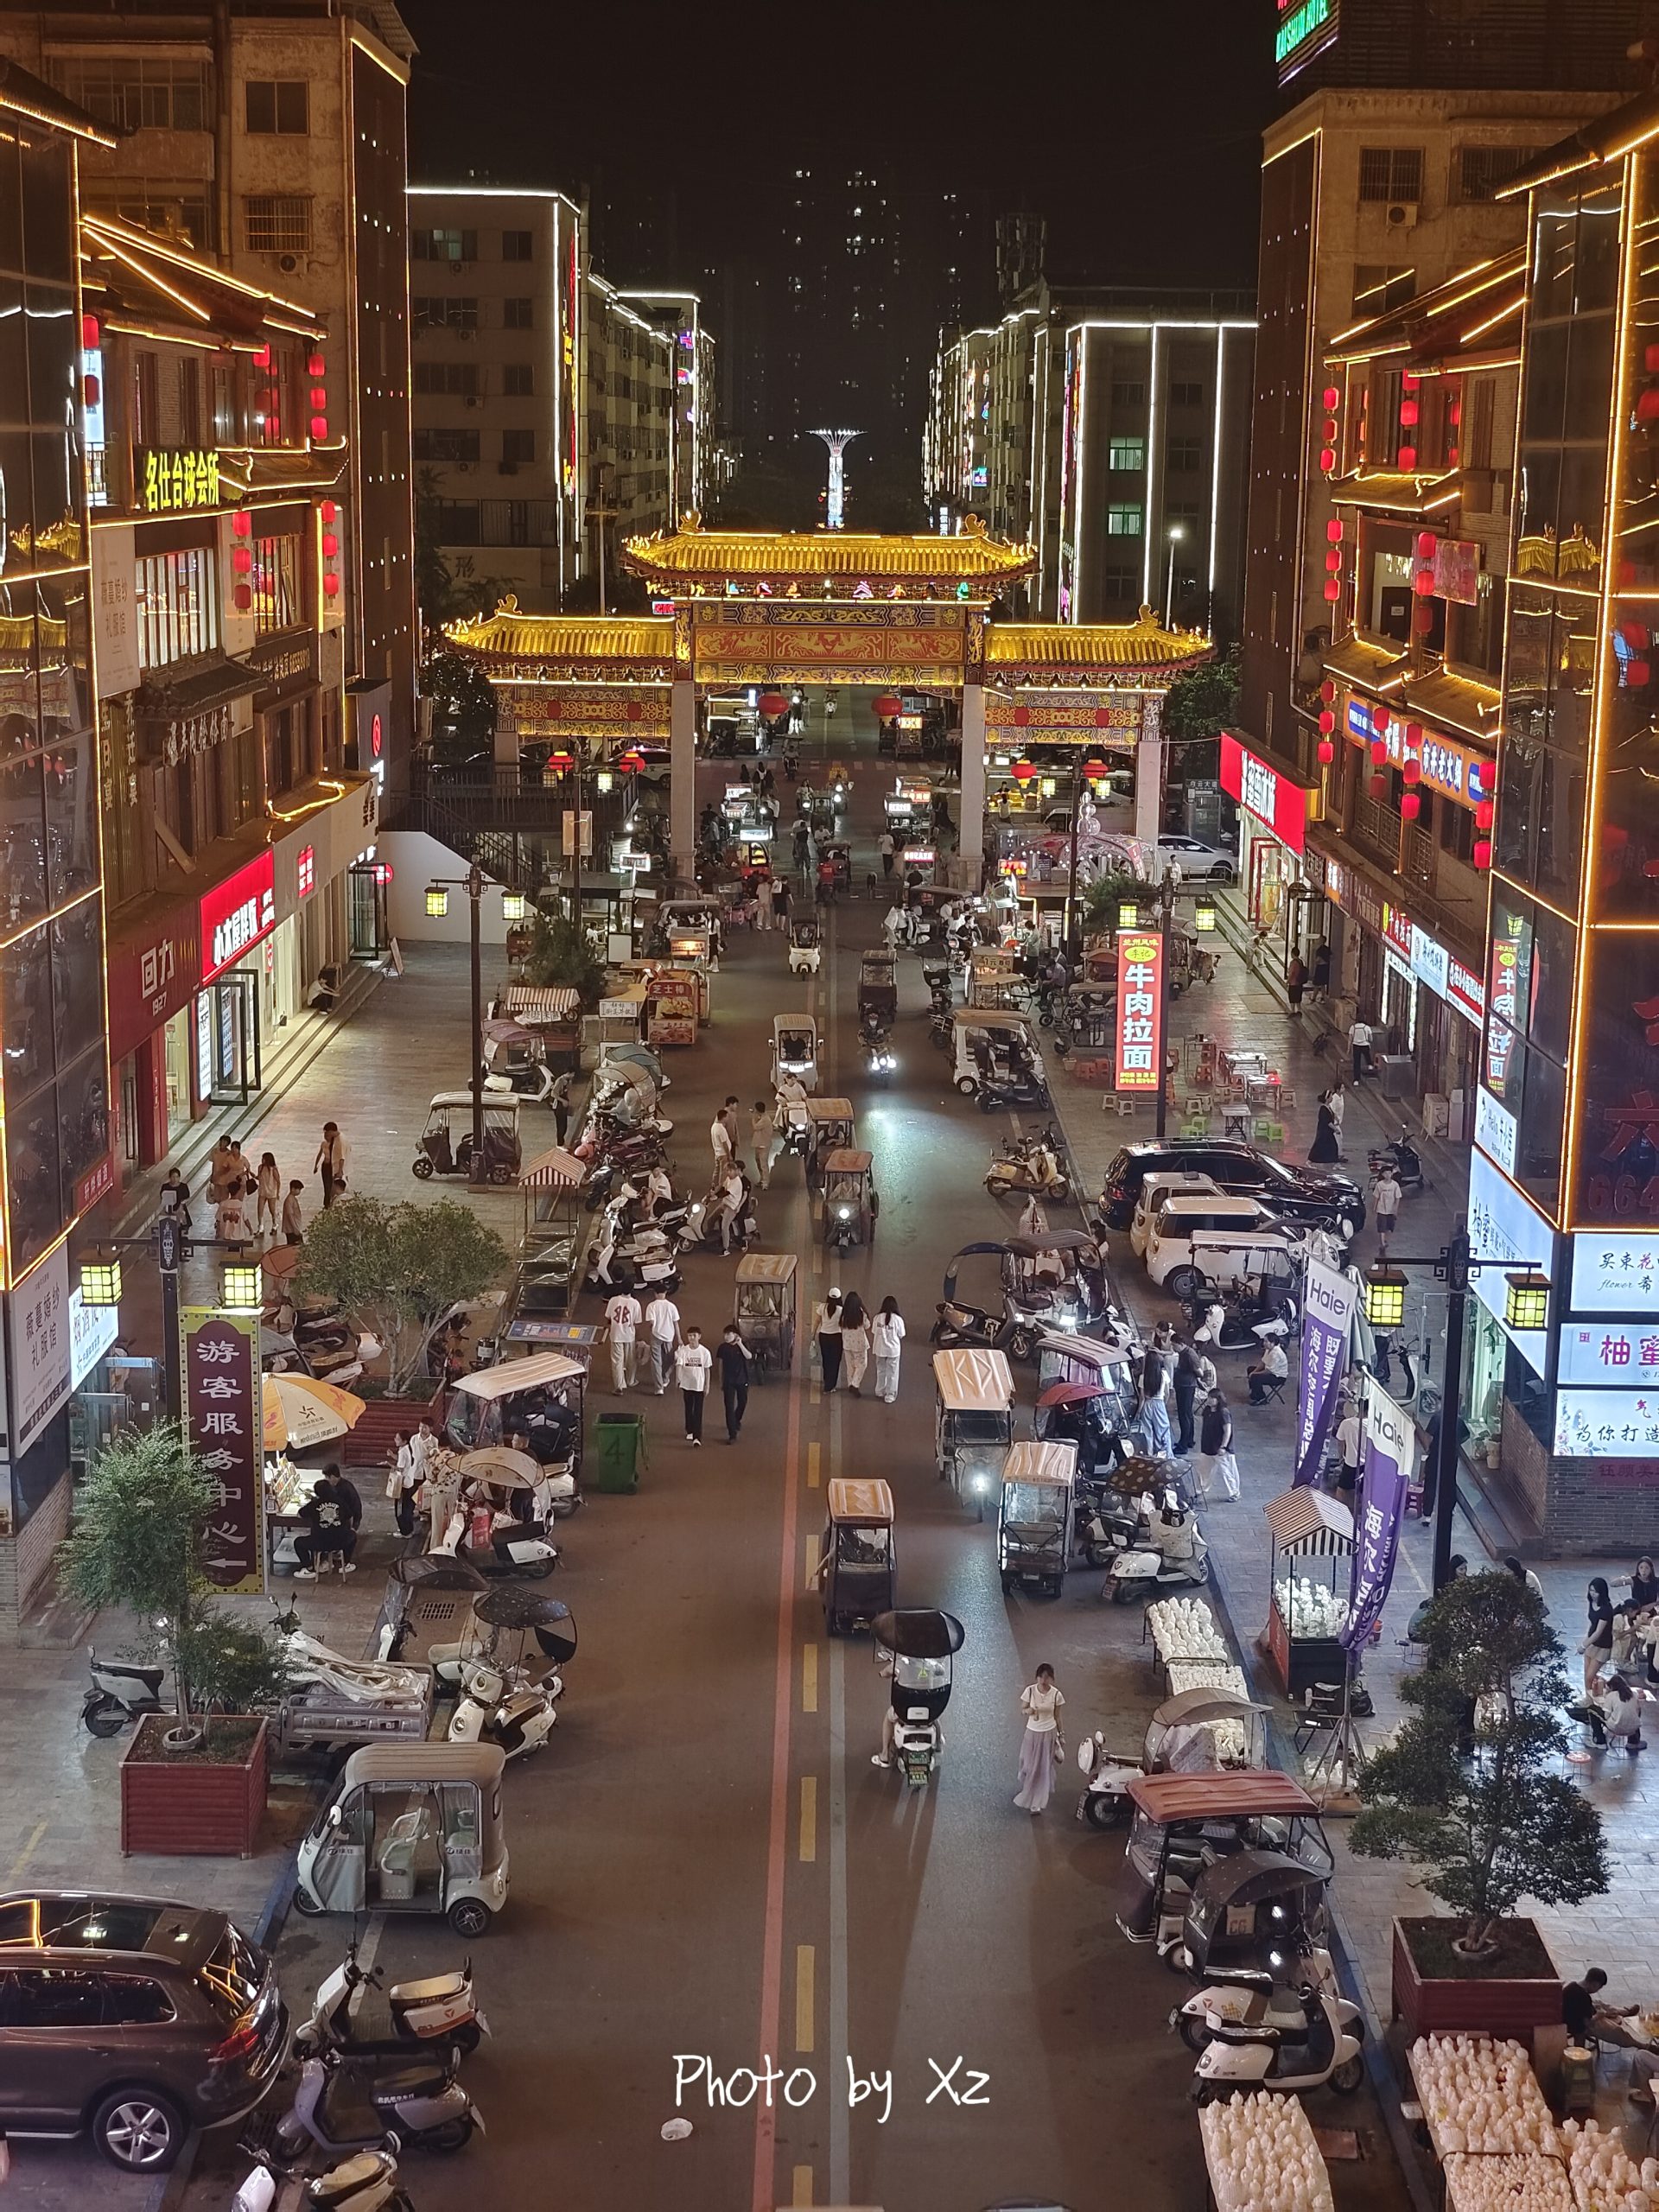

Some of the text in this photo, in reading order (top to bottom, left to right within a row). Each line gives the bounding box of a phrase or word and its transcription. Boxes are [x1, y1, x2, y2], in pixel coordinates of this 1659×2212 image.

[146, 449, 219, 512] 名仕台球会所
[141, 938, 175, 999] 回力
[152, 991, 167, 1016] 1927
[1123, 963, 1154, 1070] 牛肉拉面
[1599, 1252, 1659, 1271] 买束花
[1599, 1335, 1659, 1366] 柚蜜
[196, 1340, 247, 1543] 游客服务中心
[1374, 1405, 1404, 1452] Haie
[1576, 1424, 1659, 1444] 为你打造
